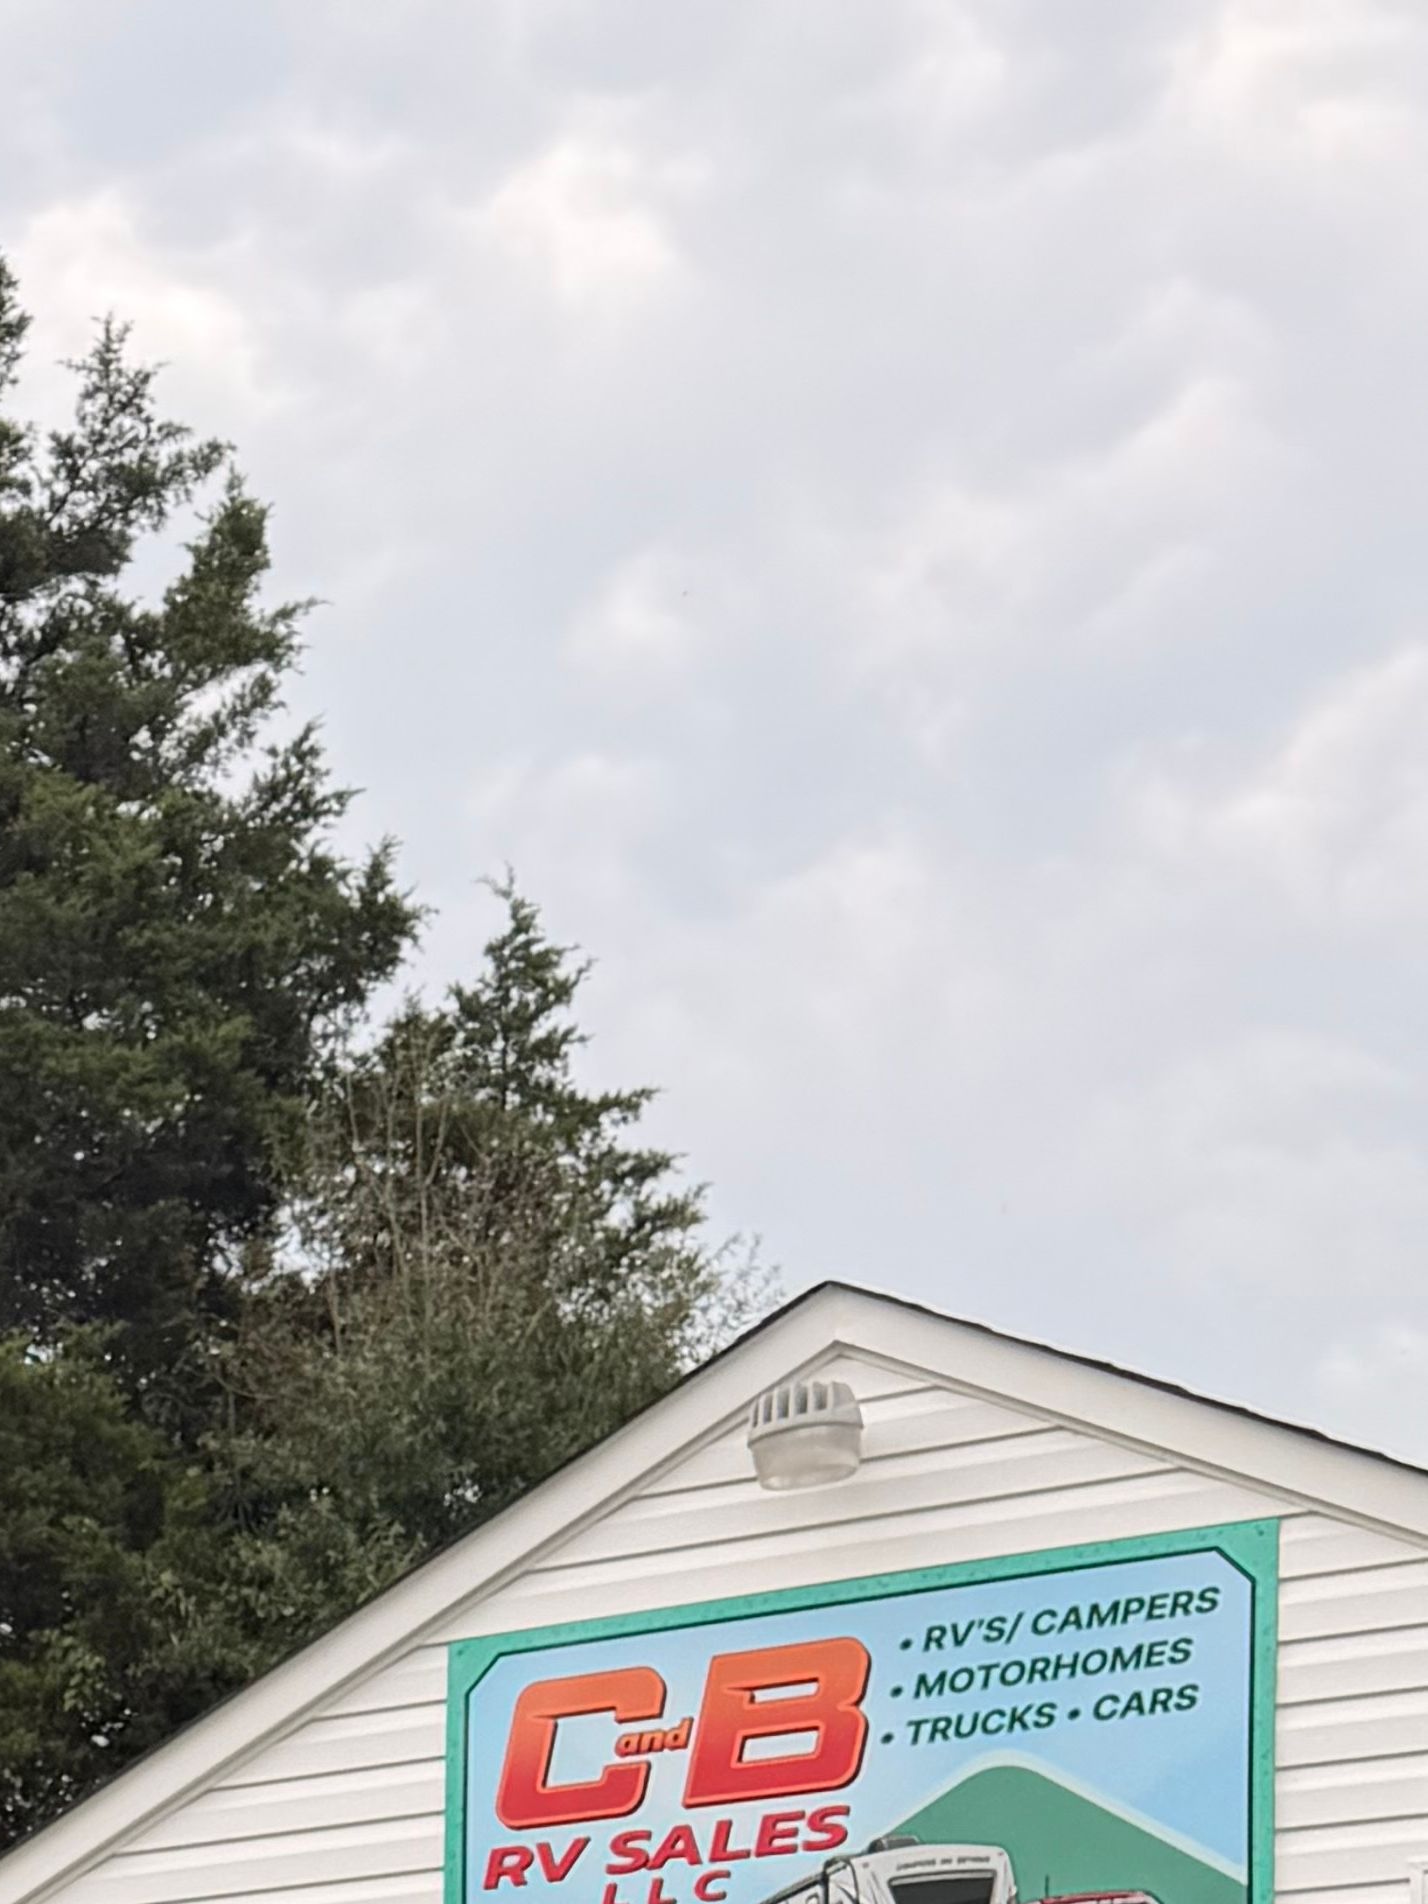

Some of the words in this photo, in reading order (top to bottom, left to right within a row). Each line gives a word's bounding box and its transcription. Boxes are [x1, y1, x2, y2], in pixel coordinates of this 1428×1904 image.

[1031, 1586, 1221, 1637] CAMPERS
[913, 1637, 1194, 1700] MOTORHOMES
[496, 1666, 666, 1830] C
[615, 1717, 693, 1758] and
[683, 1636, 871, 1808] B
[906, 1702, 1057, 1746] TRUCKS
[1092, 1684, 1200, 1722] CARS
[482, 1836, 590, 1891] RV
[605, 1805, 850, 1875] SALES
